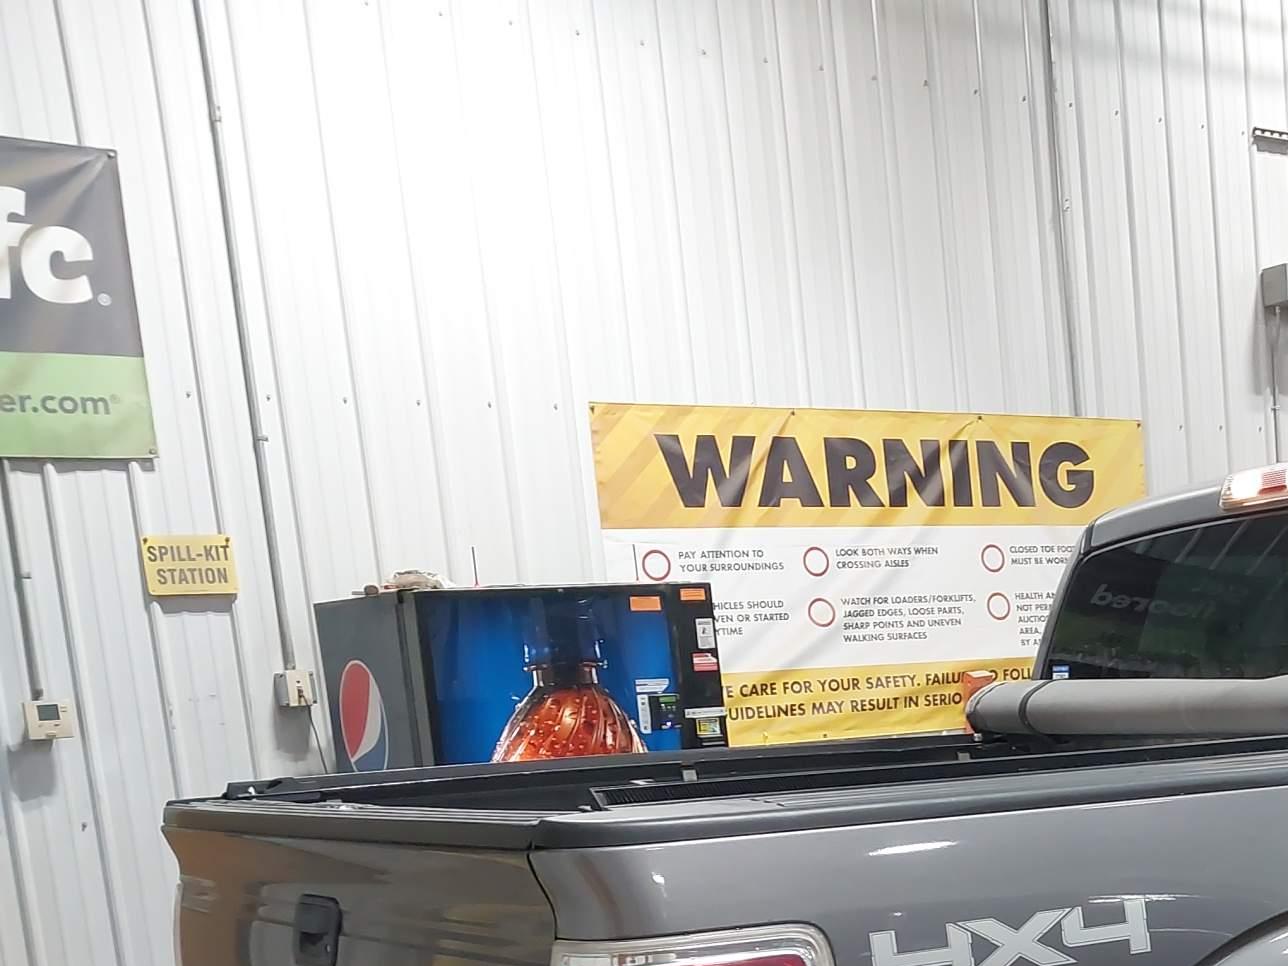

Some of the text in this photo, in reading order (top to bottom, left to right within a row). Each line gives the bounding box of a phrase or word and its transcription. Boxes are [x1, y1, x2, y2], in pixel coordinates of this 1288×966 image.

[0, 186, 94, 304] fc
[0, 395, 111, 415] er.com
[654, 434, 1095, 508] WARNING
[147, 545, 230, 562] SPILL-KIT
[678, 550, 764, 560] PAY ATTENTION TO
[835, 547, 938, 557] LOOK BOTH WAYS WHEN
[1009, 546, 1038, 554] CLOSED
[680, 562, 784, 573] YOUR SURROUNDINGS
[836, 560, 909, 569] CROSSING AISLES
[156, 567, 229, 585] STATION
[841, 594, 976, 606] WATCH FOR LOADERS/FORKLIFTS,
[1015, 592, 1043, 600] HEALTH
[712, 600, 784, 610] HICLES SHOULD
[1016, 604, 1032, 612] NOT
[843, 606, 965, 618] JAGGED EDGES, LOOSE PARTS,
[714, 613, 789, 623] VEN OR STARTED
[843, 618, 961, 631] SHARP POINTS AND UNEVEN
[715, 627, 743, 636] YTIME
[843, 632, 928, 643] WALKING SURFACES
[725, 685, 734, 698] E
[739, 682, 777, 697] CARE
[782, 681, 813, 695] FOR
[817, 677, 860, 692] YOUR
[866, 674, 921, 689] SAFETY.
[1003, 668, 1031, 681] FOLL
[728, 703, 806, 720] UIDELINES
[812, 700, 846, 715] MAY
[851, 697, 898, 712] RESULT
[903, 695, 919, 708] IN
[924, 692, 962, 707] SERIO
